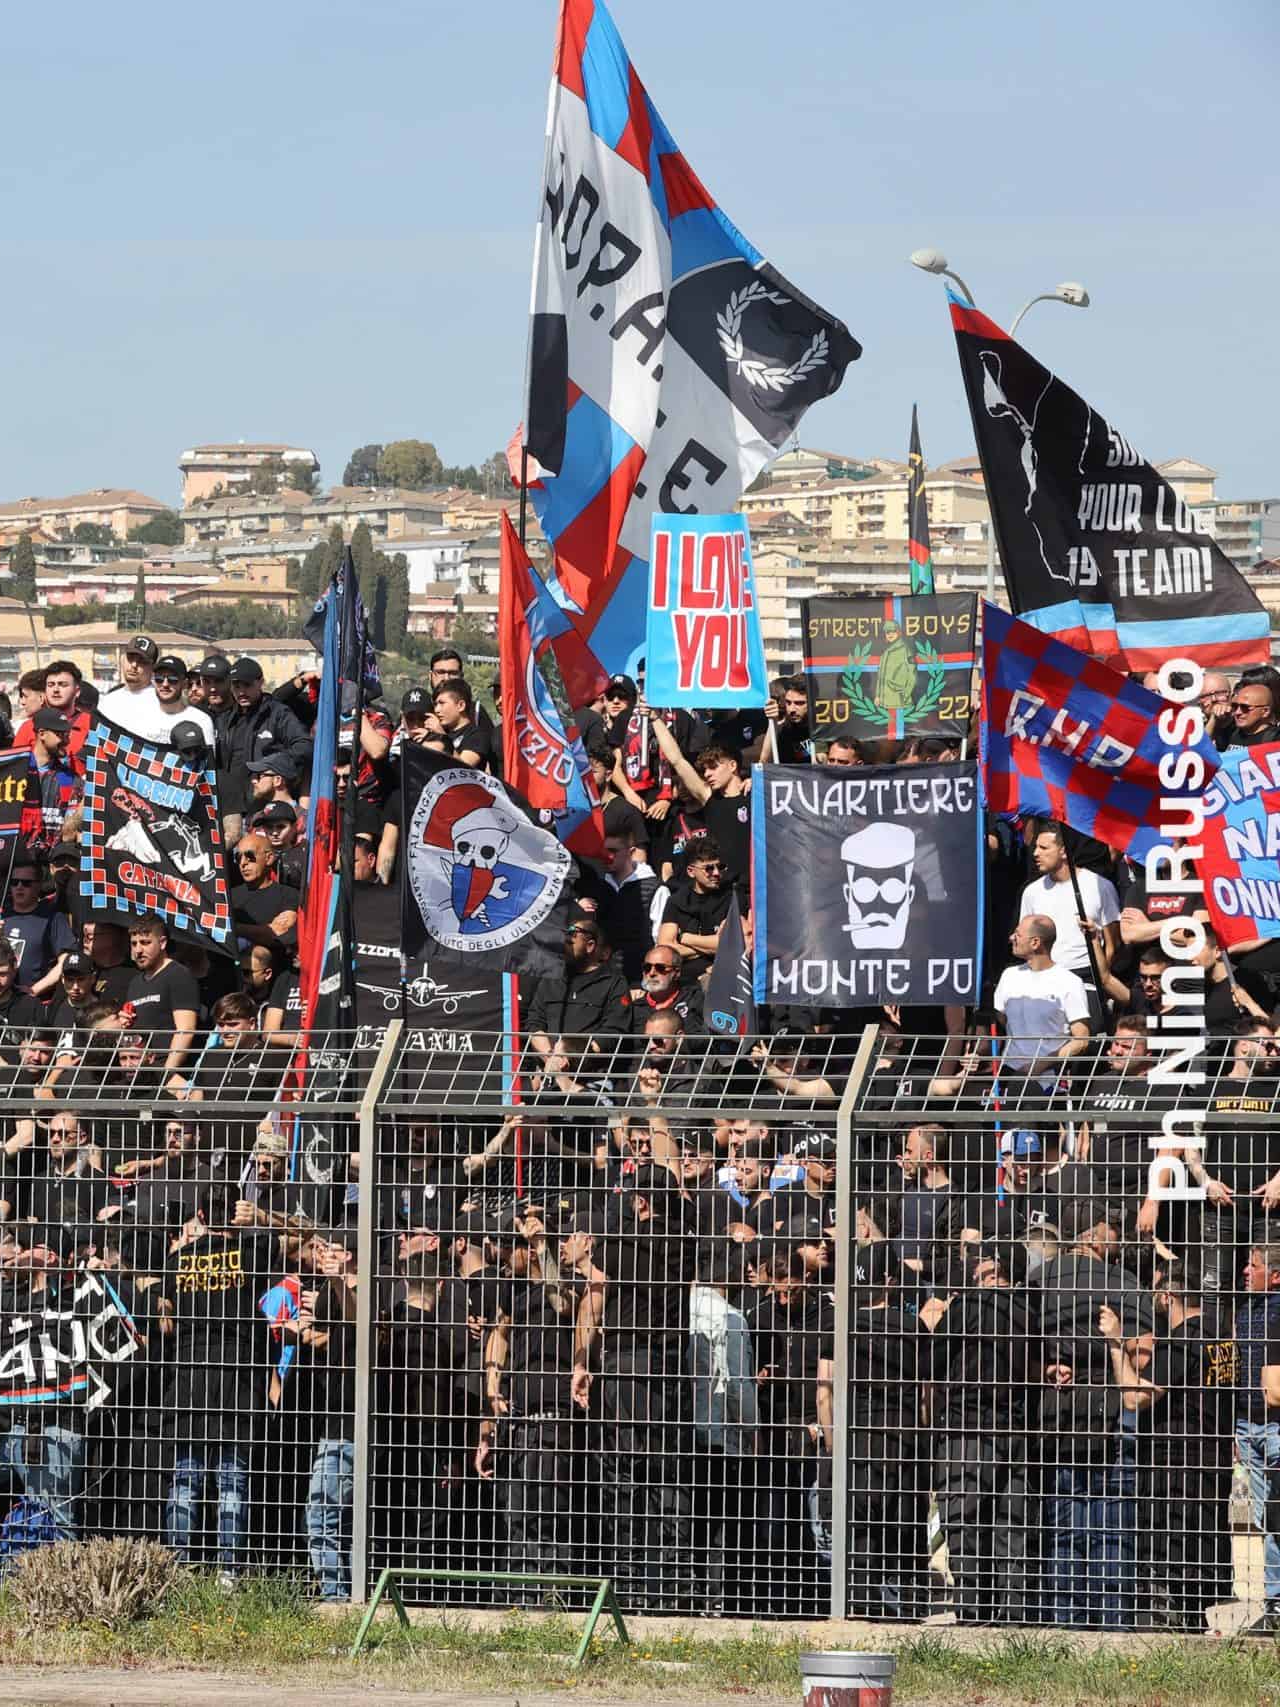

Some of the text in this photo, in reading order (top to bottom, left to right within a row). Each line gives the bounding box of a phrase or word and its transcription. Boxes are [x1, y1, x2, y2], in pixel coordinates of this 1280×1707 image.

[1077, 484, 1142, 532] YOUR
[651, 530, 754, 612] I LOVE
[1113, 546, 1214, 597] TEAM!
[809, 613, 970, 638] STREET BOYS
[671, 611, 752, 691] YOU
[815, 696, 970, 724] 20 22
[118, 861, 200, 905] CATANIA
[469, 935, 506, 951] DEGLI
[511, 908, 547, 940] ULTRA
[772, 958, 911, 995] MONTE
[927, 957, 974, 995] PO
[357, 1025, 474, 1052] CAANIA
[178, 1250, 241, 1272] CICCIO
[176, 1269, 245, 1294] FAMOSO
